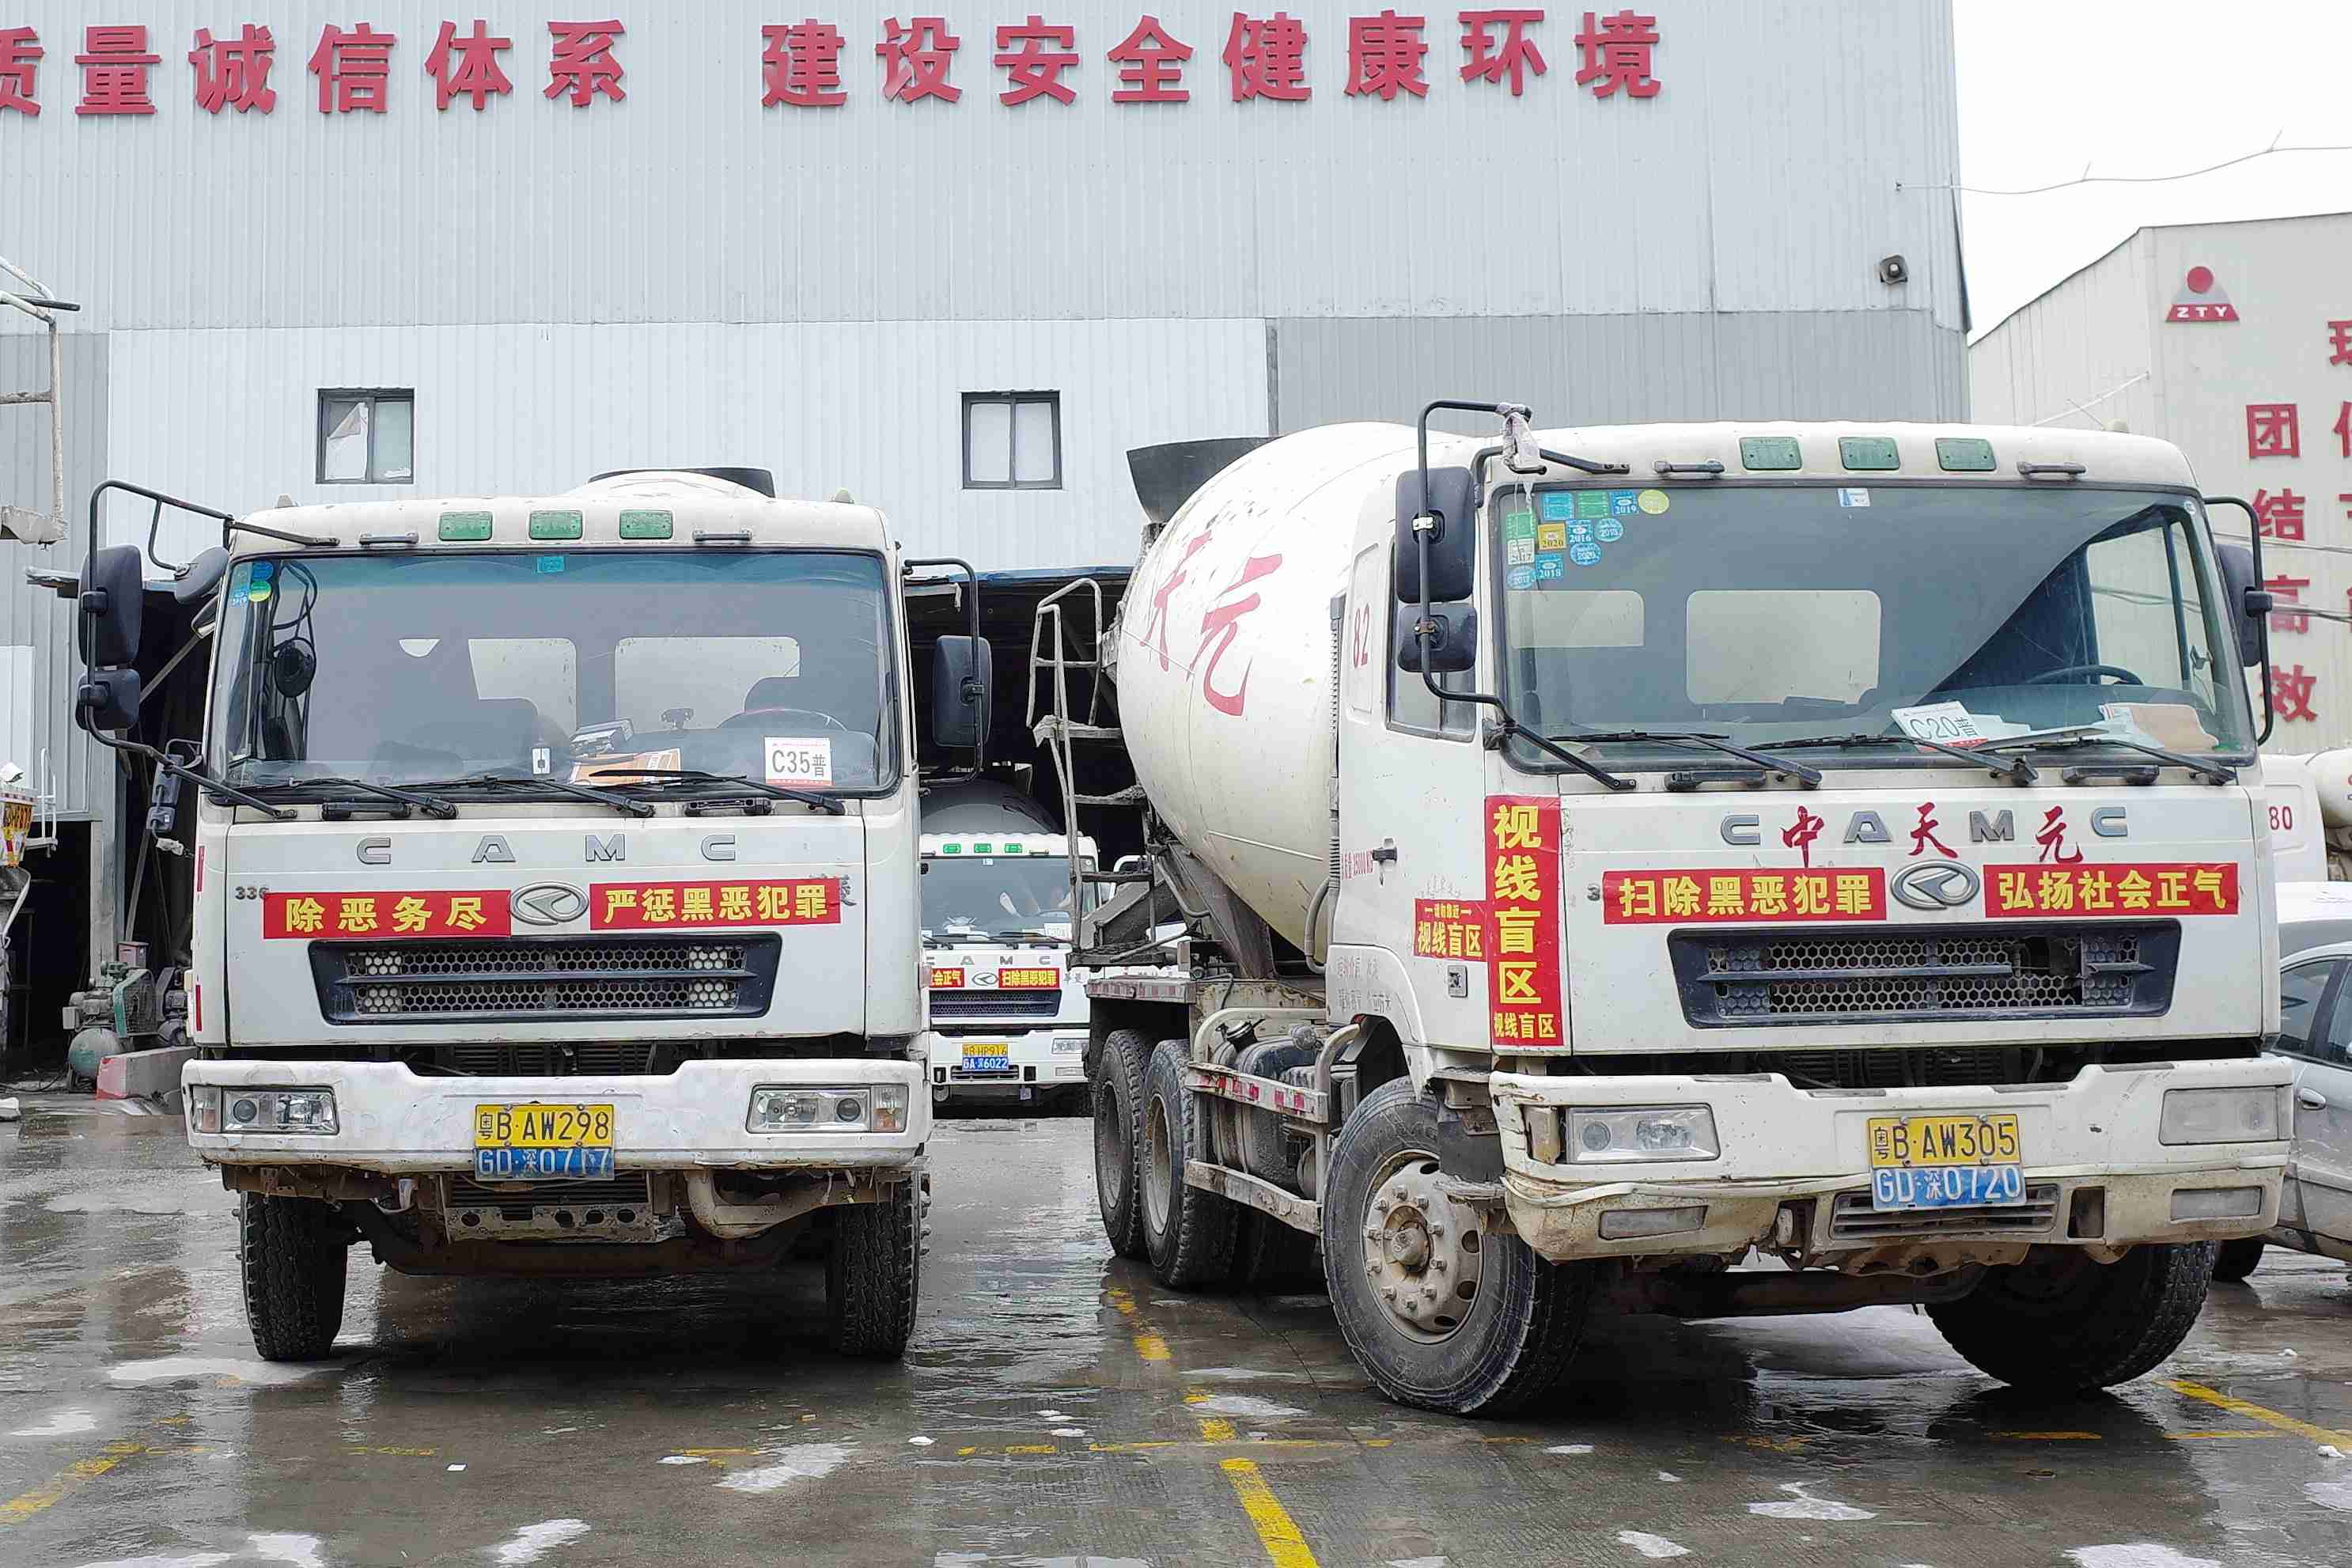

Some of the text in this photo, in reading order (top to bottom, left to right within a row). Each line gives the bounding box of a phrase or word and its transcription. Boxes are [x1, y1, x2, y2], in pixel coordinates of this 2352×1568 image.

[761, 9, 1662, 108] 建设安全健康环境
[2176, 305, 2228, 318] ZTY
[772, 750, 826, 777] C35普
[2268, 805, 2293, 831] 80
[604, 884, 828, 923] 严惩黑恶犯罪
[1494, 805, 1542, 1004] 视线盲区
[1619, 873, 1873, 917] 扫除黑恶犯罪
[1998, 869, 2227, 911] 弘扬社会正气
[286, 896, 487, 932] 除恶务尽
[1418, 921, 1483, 956] 视线盲区
[931, 969, 962, 986] 会正气
[1494, 1013, 1557, 1039] 视线盲区
